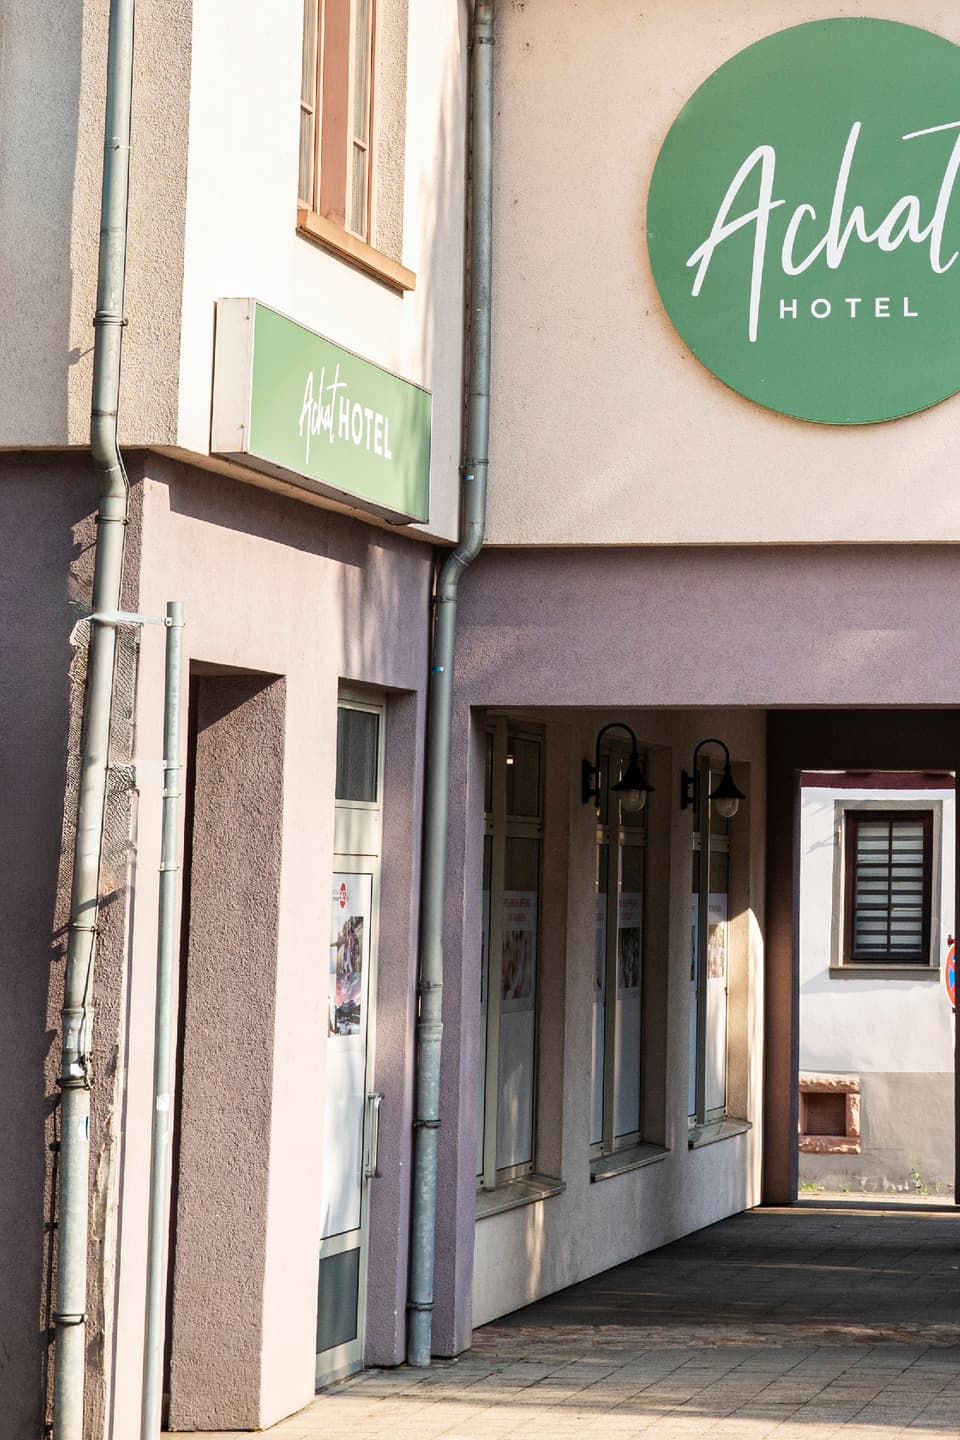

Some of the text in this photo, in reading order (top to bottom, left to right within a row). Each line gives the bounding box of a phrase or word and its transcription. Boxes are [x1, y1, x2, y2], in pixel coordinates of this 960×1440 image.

[779, 296, 919, 320] HOTEL
[299, 363, 393, 465] Achat HOTEL
